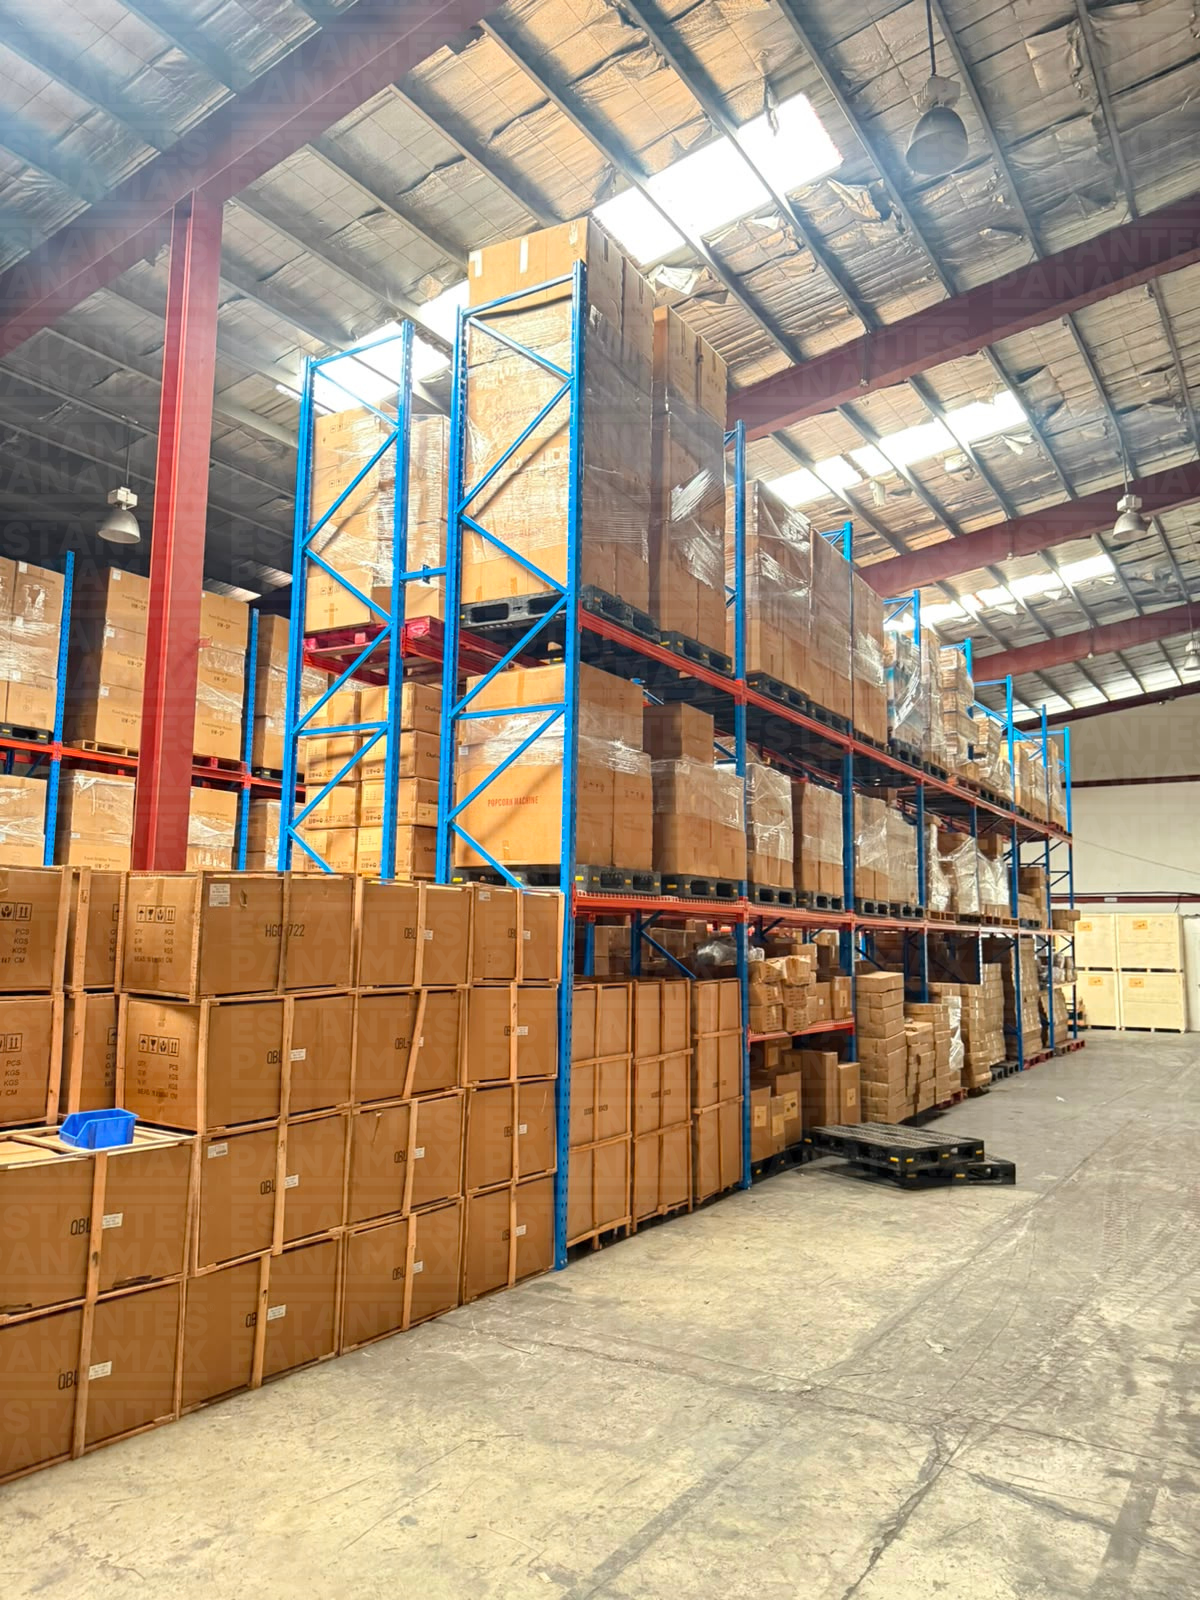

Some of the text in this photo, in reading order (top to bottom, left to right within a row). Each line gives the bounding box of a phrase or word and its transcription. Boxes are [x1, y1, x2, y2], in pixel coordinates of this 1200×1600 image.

[488, 796, 538, 807] POPCORN MACHINE
[15, 928, 30, 936] PCS
